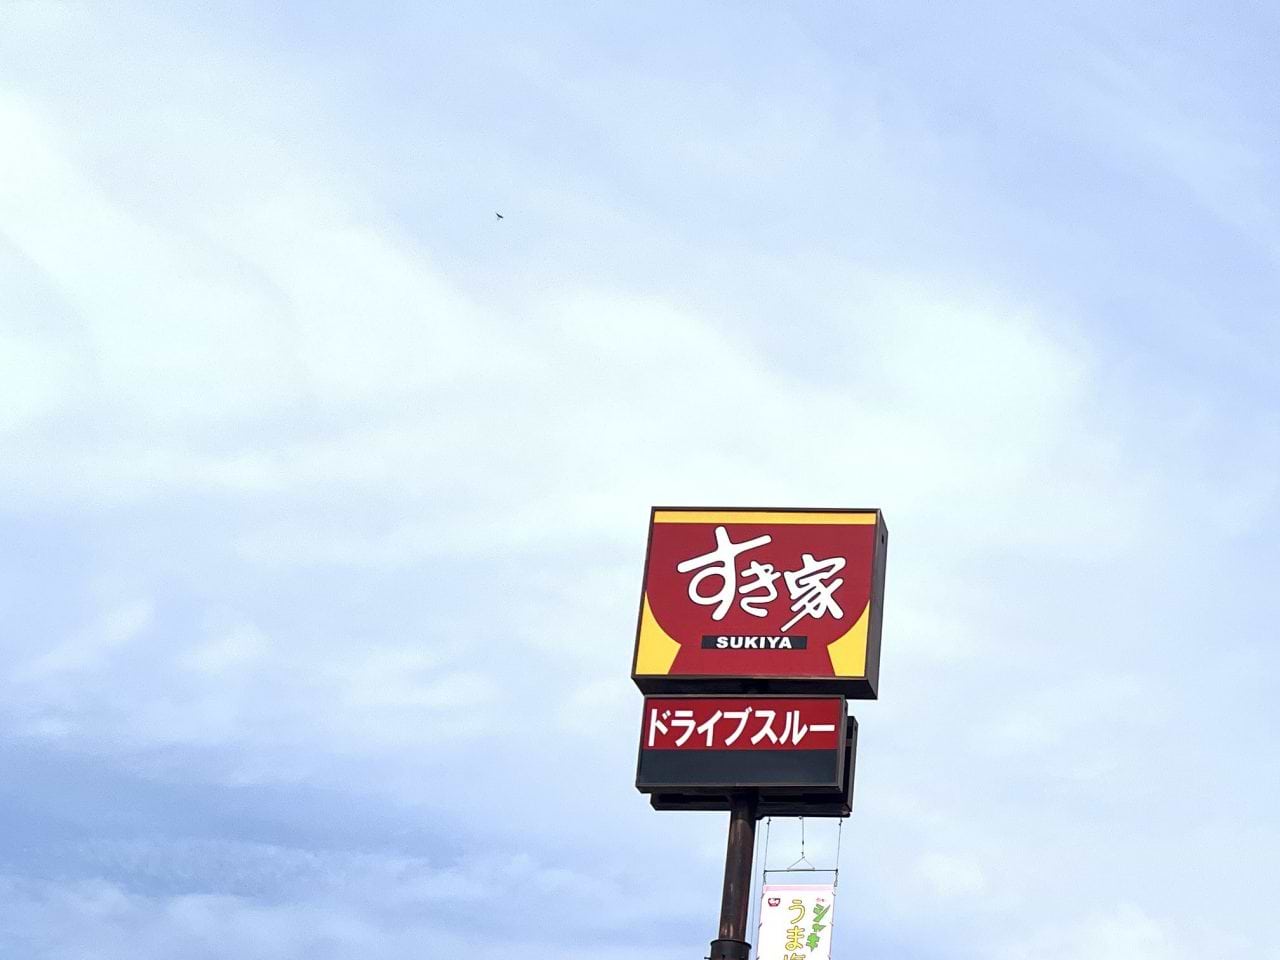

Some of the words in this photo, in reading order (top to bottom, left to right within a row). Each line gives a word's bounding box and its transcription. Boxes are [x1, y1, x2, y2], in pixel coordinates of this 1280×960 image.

[677, 526, 847, 632] すき家
[716, 636, 792, 649] SUKIYA
[648, 706, 836, 747] ドライブスルー
